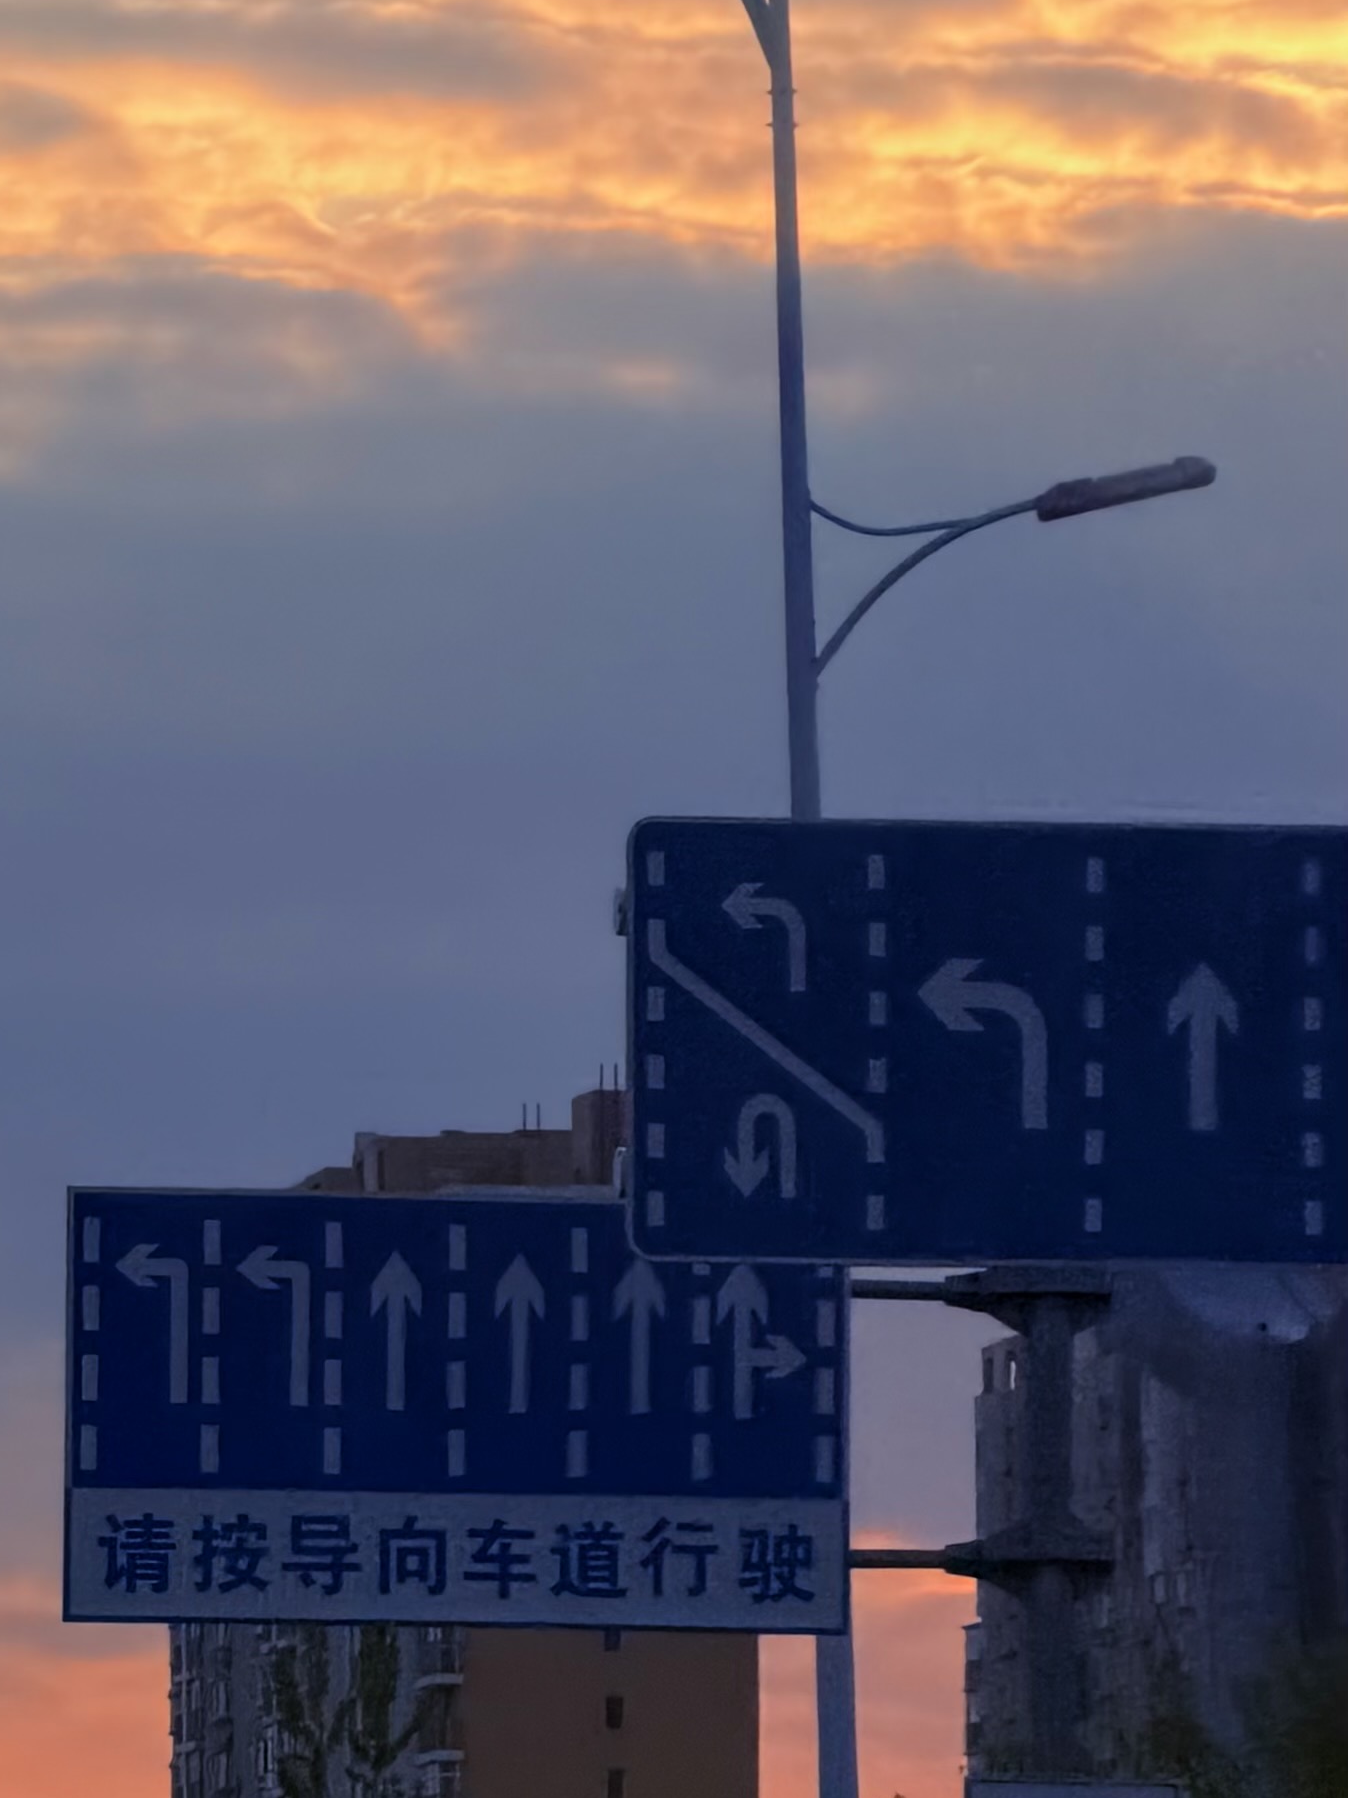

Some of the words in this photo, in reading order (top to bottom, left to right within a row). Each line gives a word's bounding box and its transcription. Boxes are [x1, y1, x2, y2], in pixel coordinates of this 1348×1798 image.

[97, 1512, 816, 1604] 请按导向车道行驶
